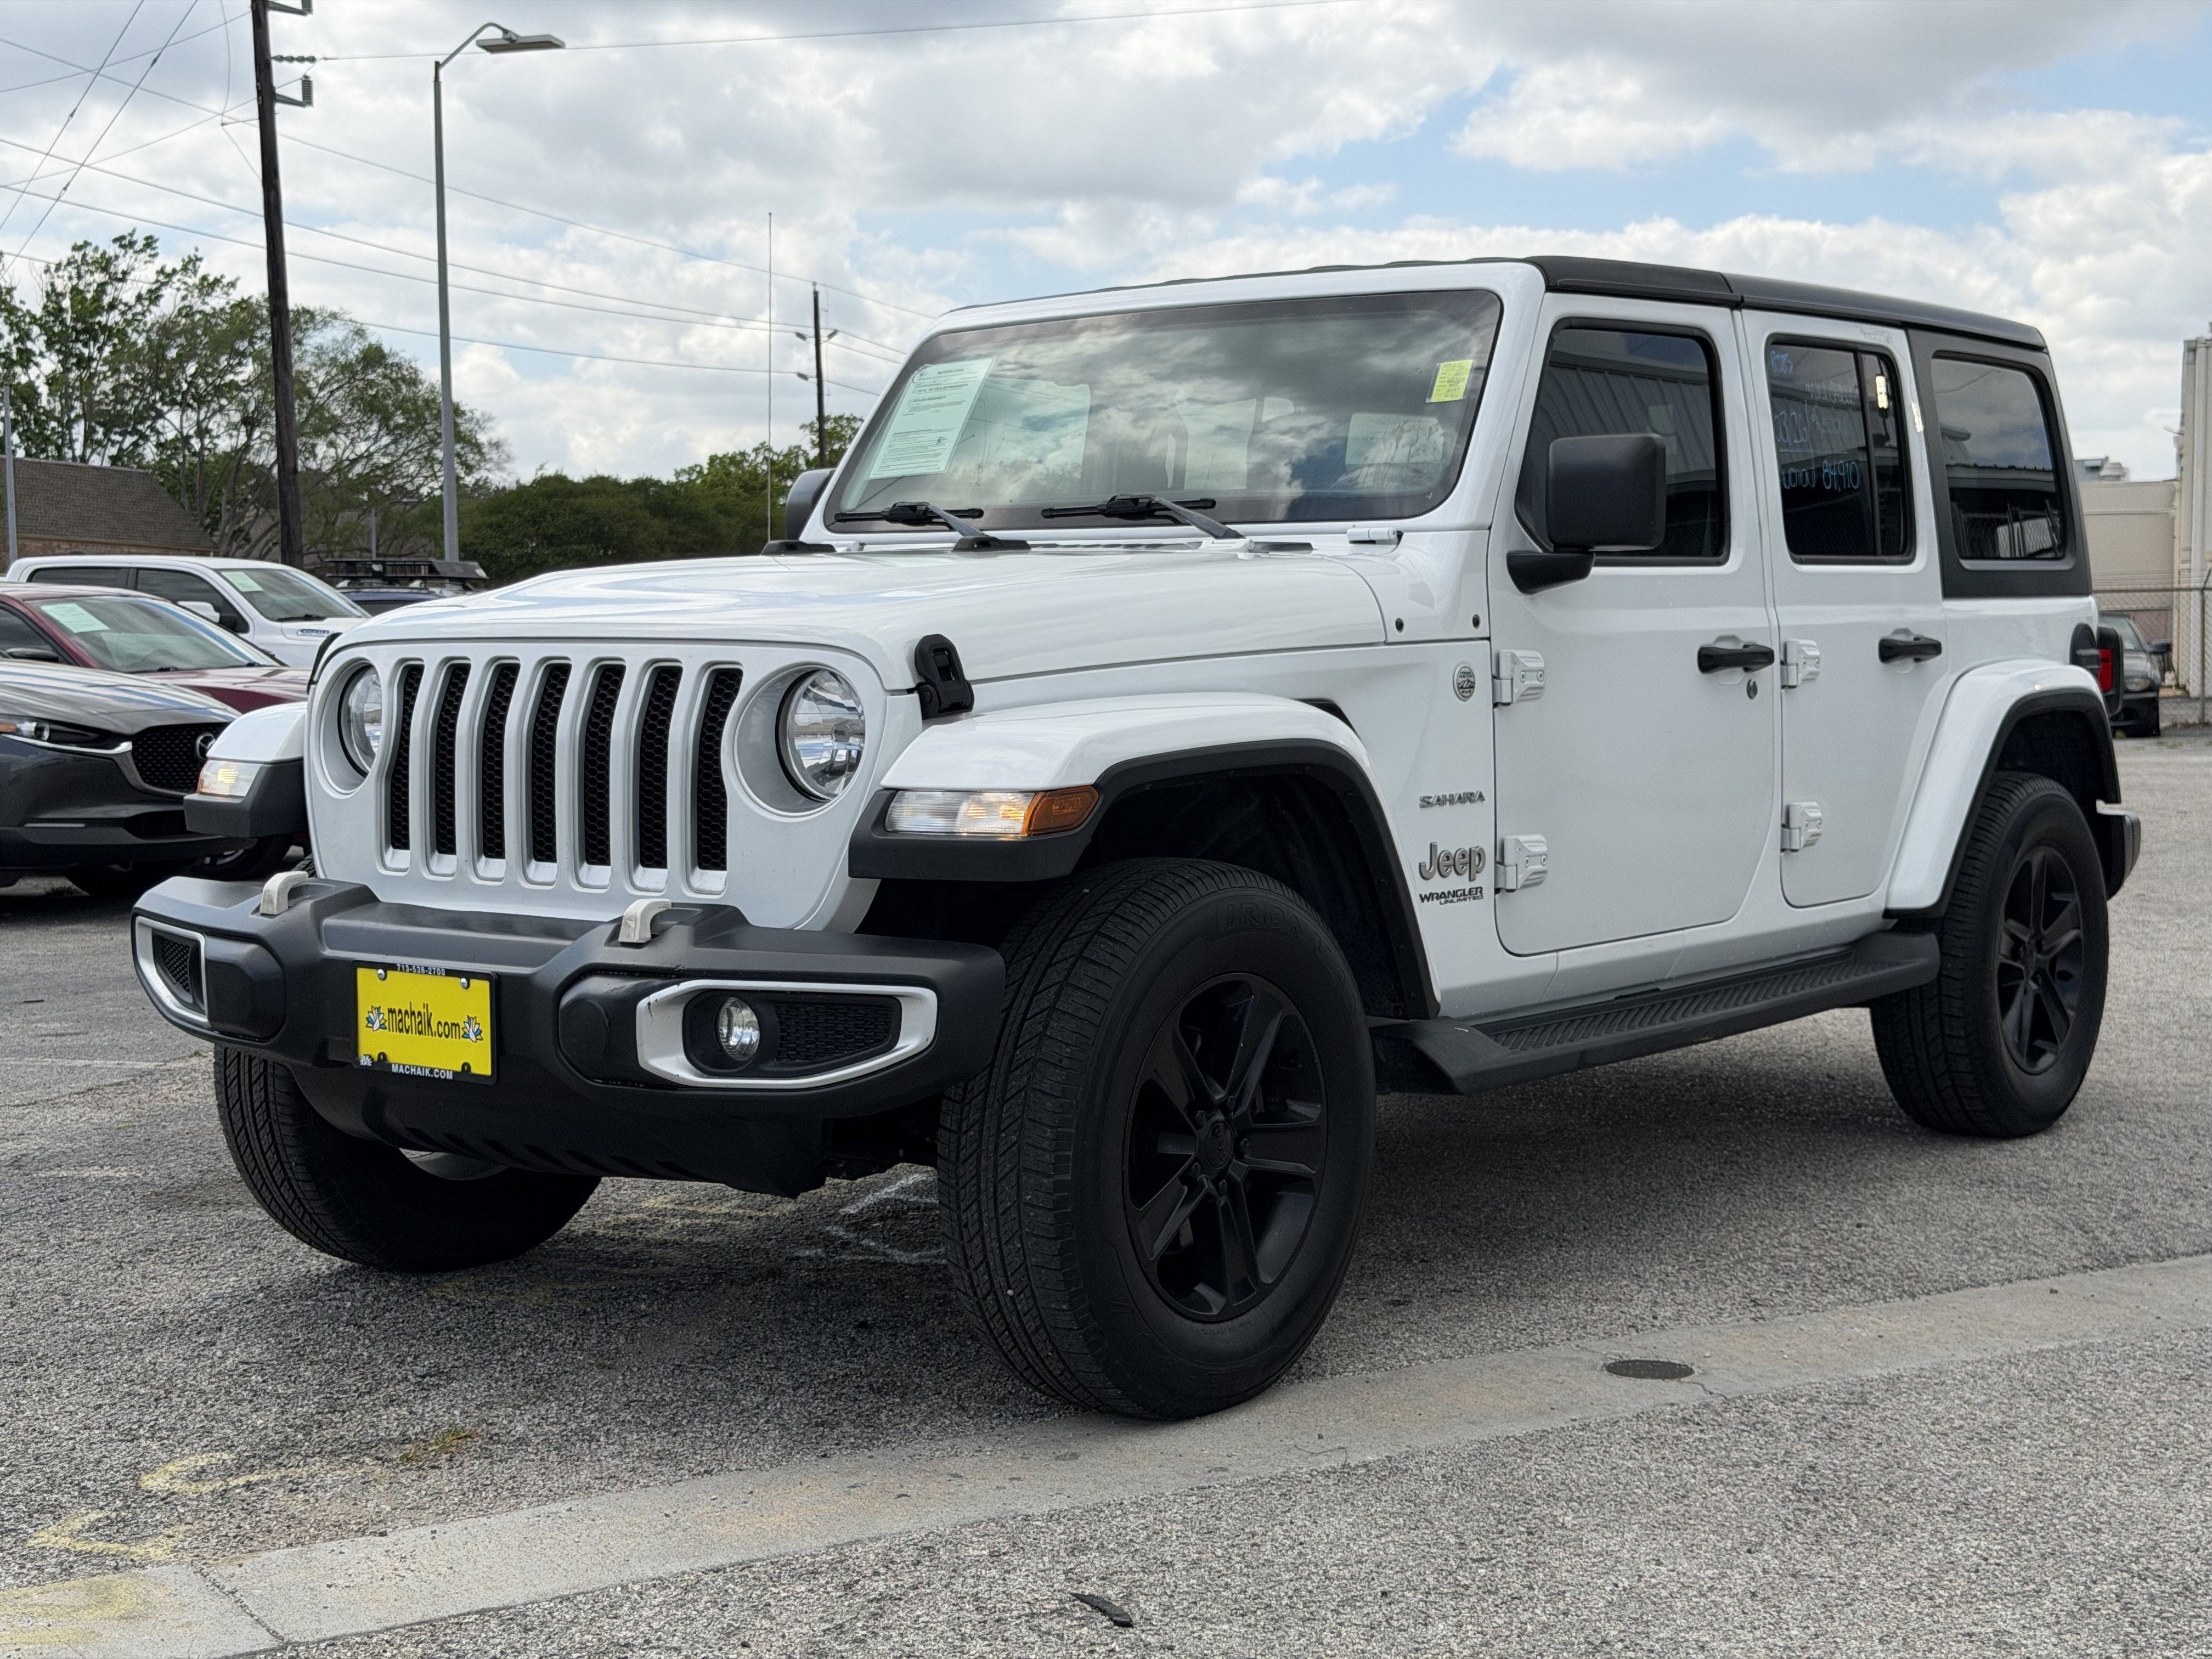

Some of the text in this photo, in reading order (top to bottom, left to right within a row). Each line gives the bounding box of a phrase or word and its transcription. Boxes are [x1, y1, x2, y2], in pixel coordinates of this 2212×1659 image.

[1419, 790, 1486, 809] SAHARA
[1418, 842, 1486, 882] Jeep
[1419, 886, 1483, 904] WRANGLER
[1439, 895, 1483, 905] UNLIMITED
[396, 963, 445, 976] 713-538-2700
[387, 1001, 461, 1040] machaik.com
[391, 1064, 454, 1080] MACHAIK.COM
